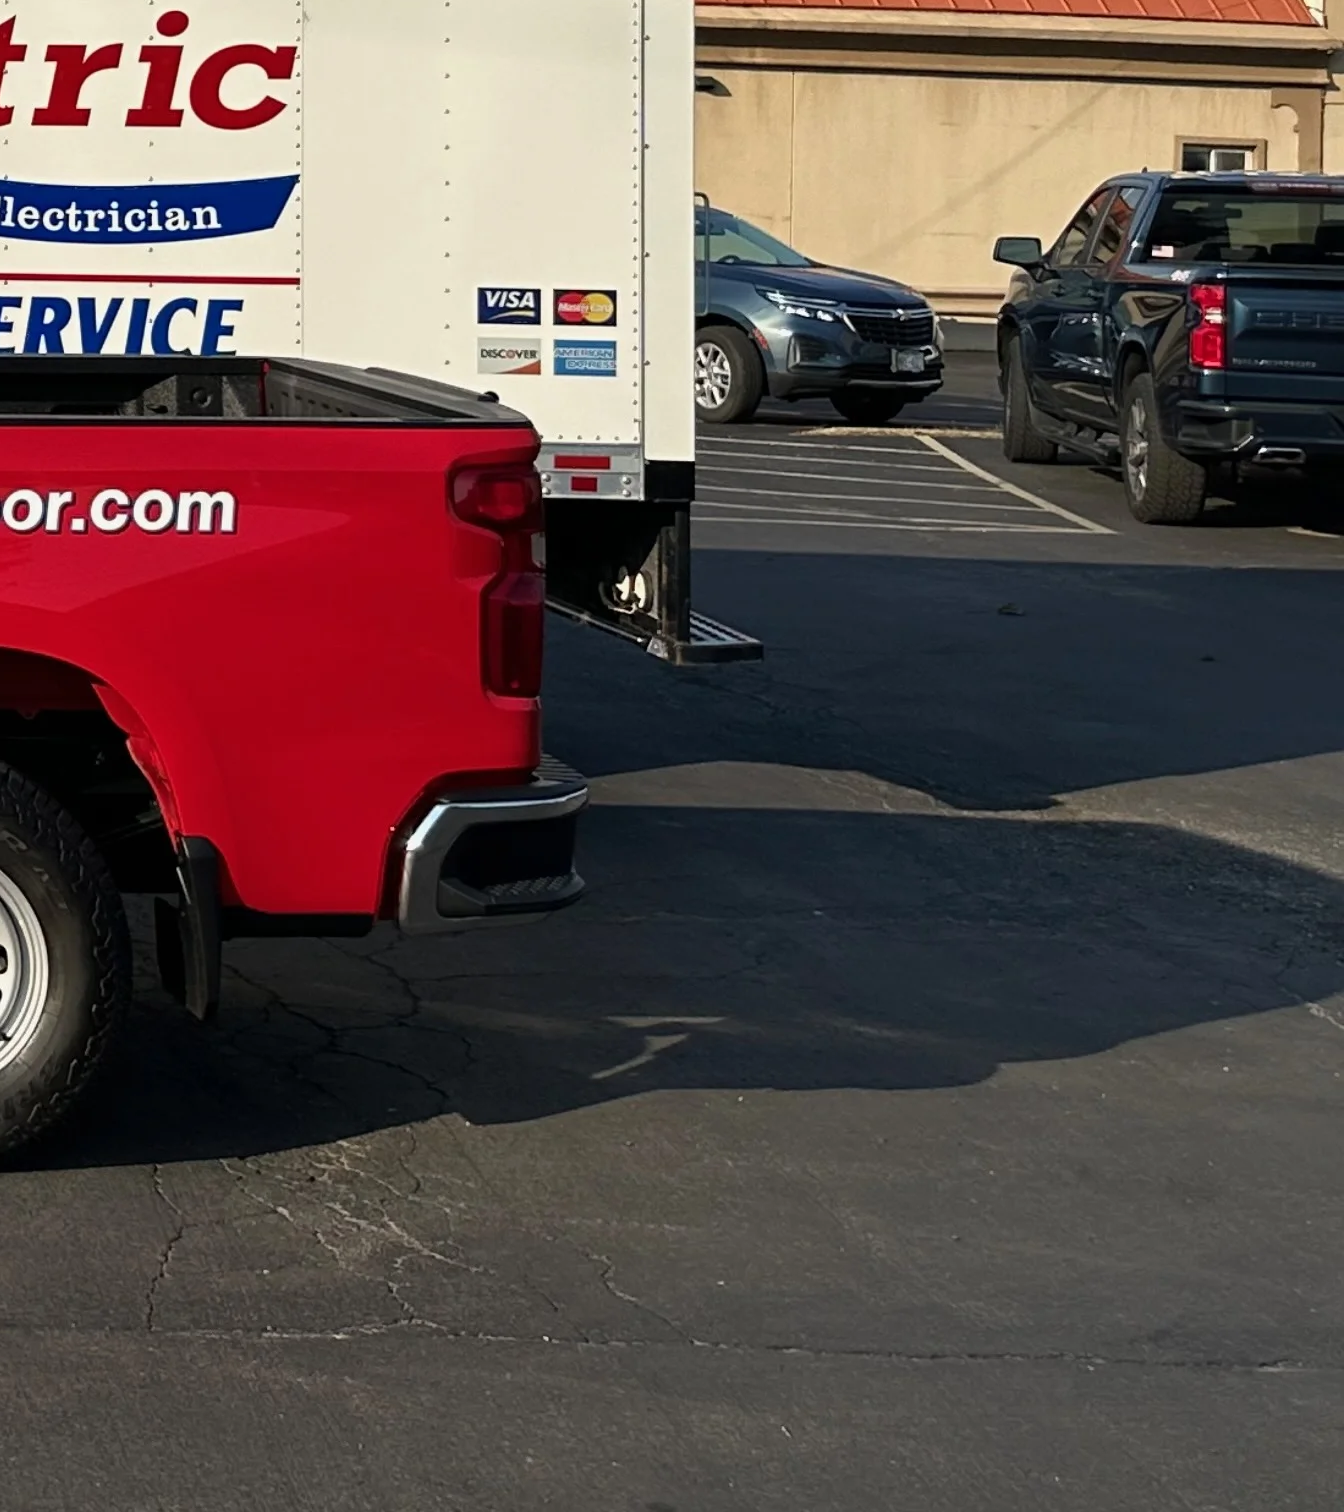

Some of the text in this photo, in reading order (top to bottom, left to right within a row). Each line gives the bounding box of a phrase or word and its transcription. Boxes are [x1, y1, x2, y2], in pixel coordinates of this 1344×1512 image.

[484, 290, 535, 308] VISA
[480, 349, 539, 360] DISCOVER
[553, 347, 614, 358] AMERICAN
[565, 359, 617, 370] EXPRESS
